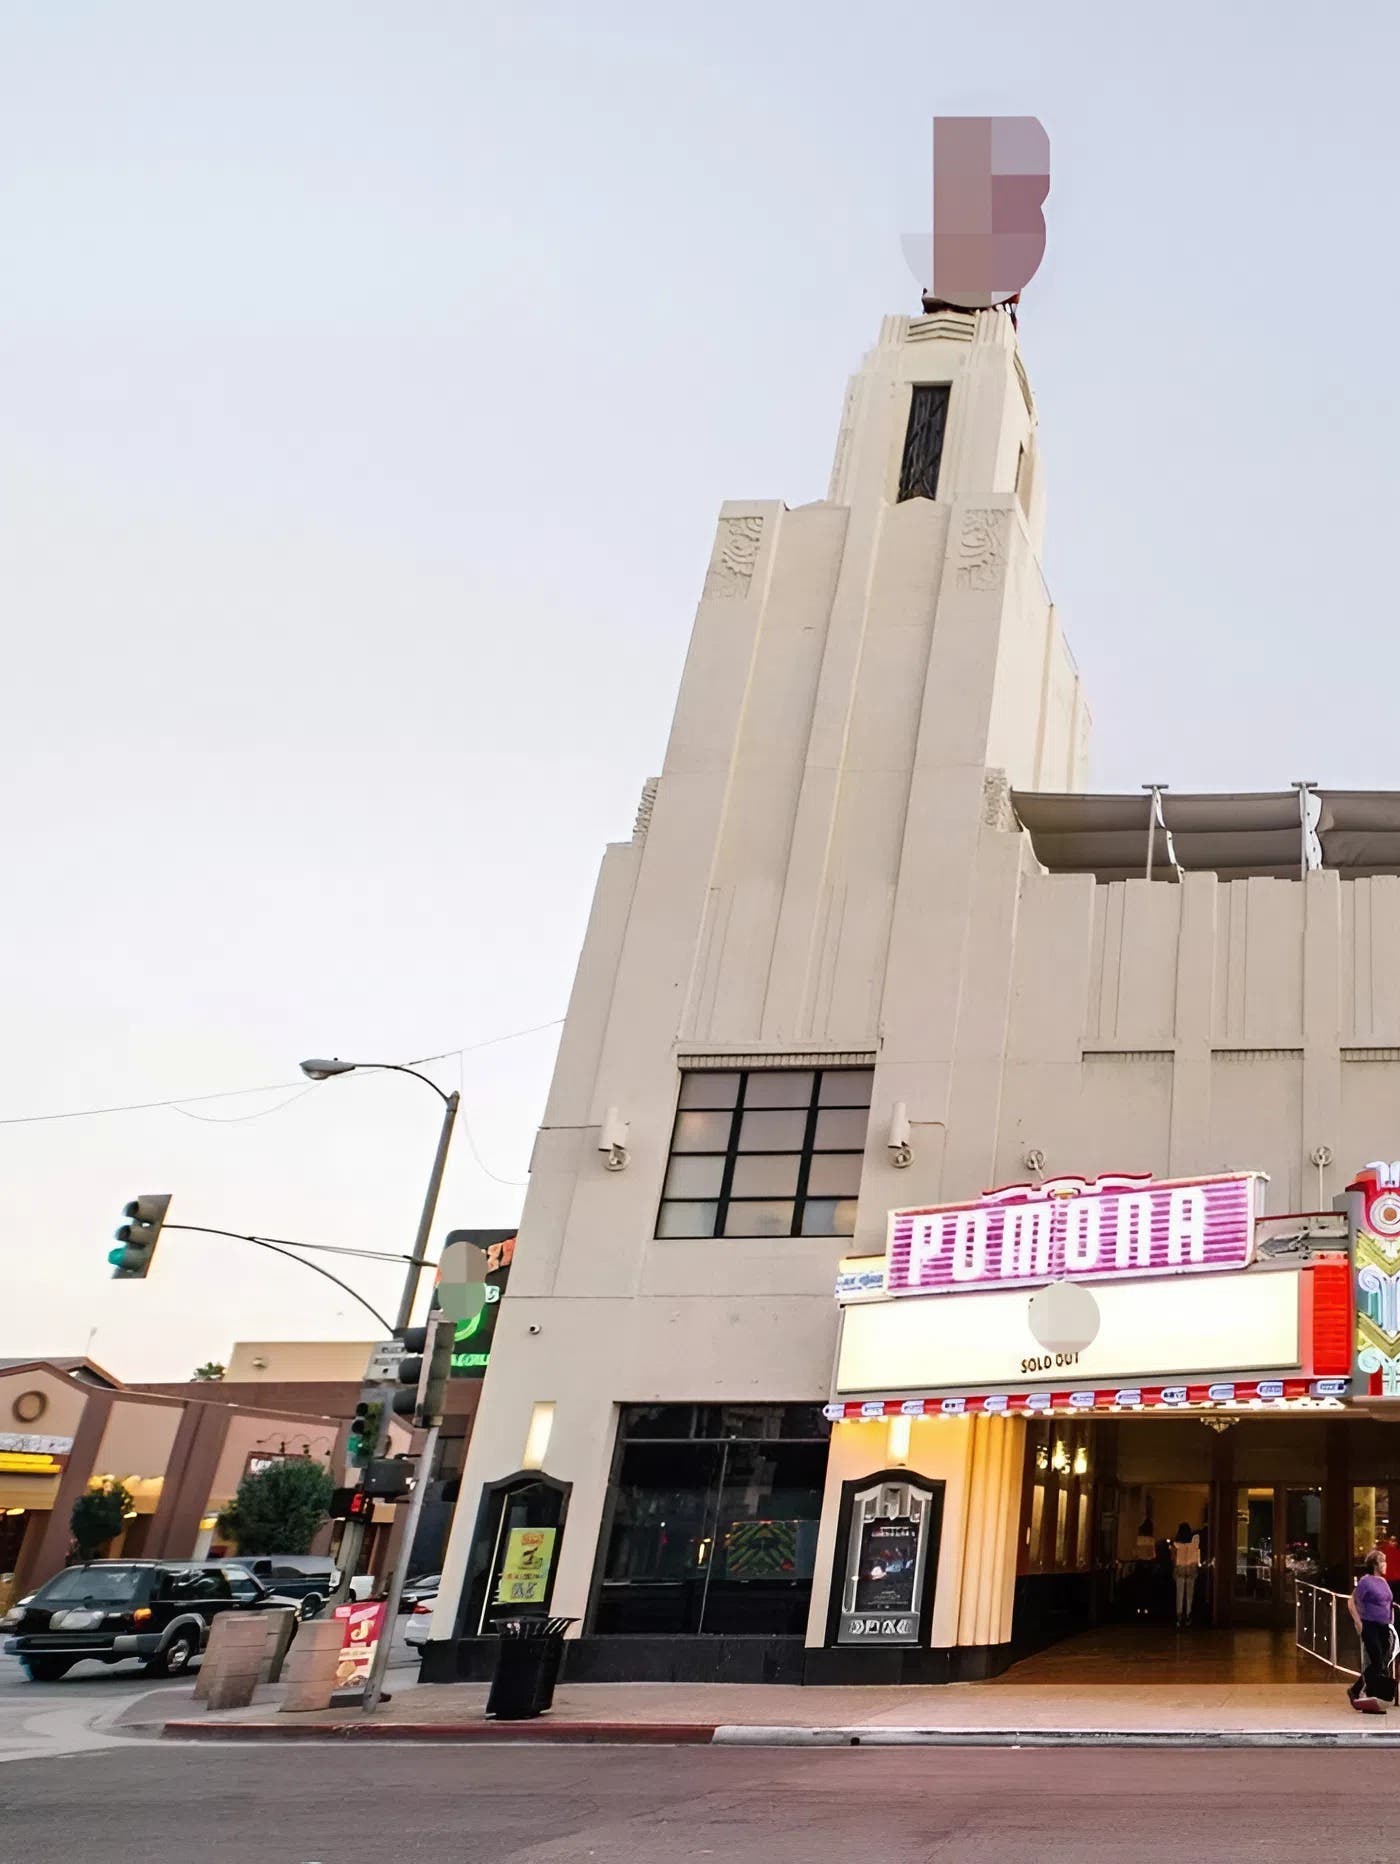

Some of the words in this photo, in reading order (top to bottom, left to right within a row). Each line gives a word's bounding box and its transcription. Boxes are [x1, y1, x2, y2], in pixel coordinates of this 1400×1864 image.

[908, 1186, 1207, 1286] POMONA
[1021, 1355, 1052, 1374] SOLD
[1055, 1351, 1079, 1367] OUT
